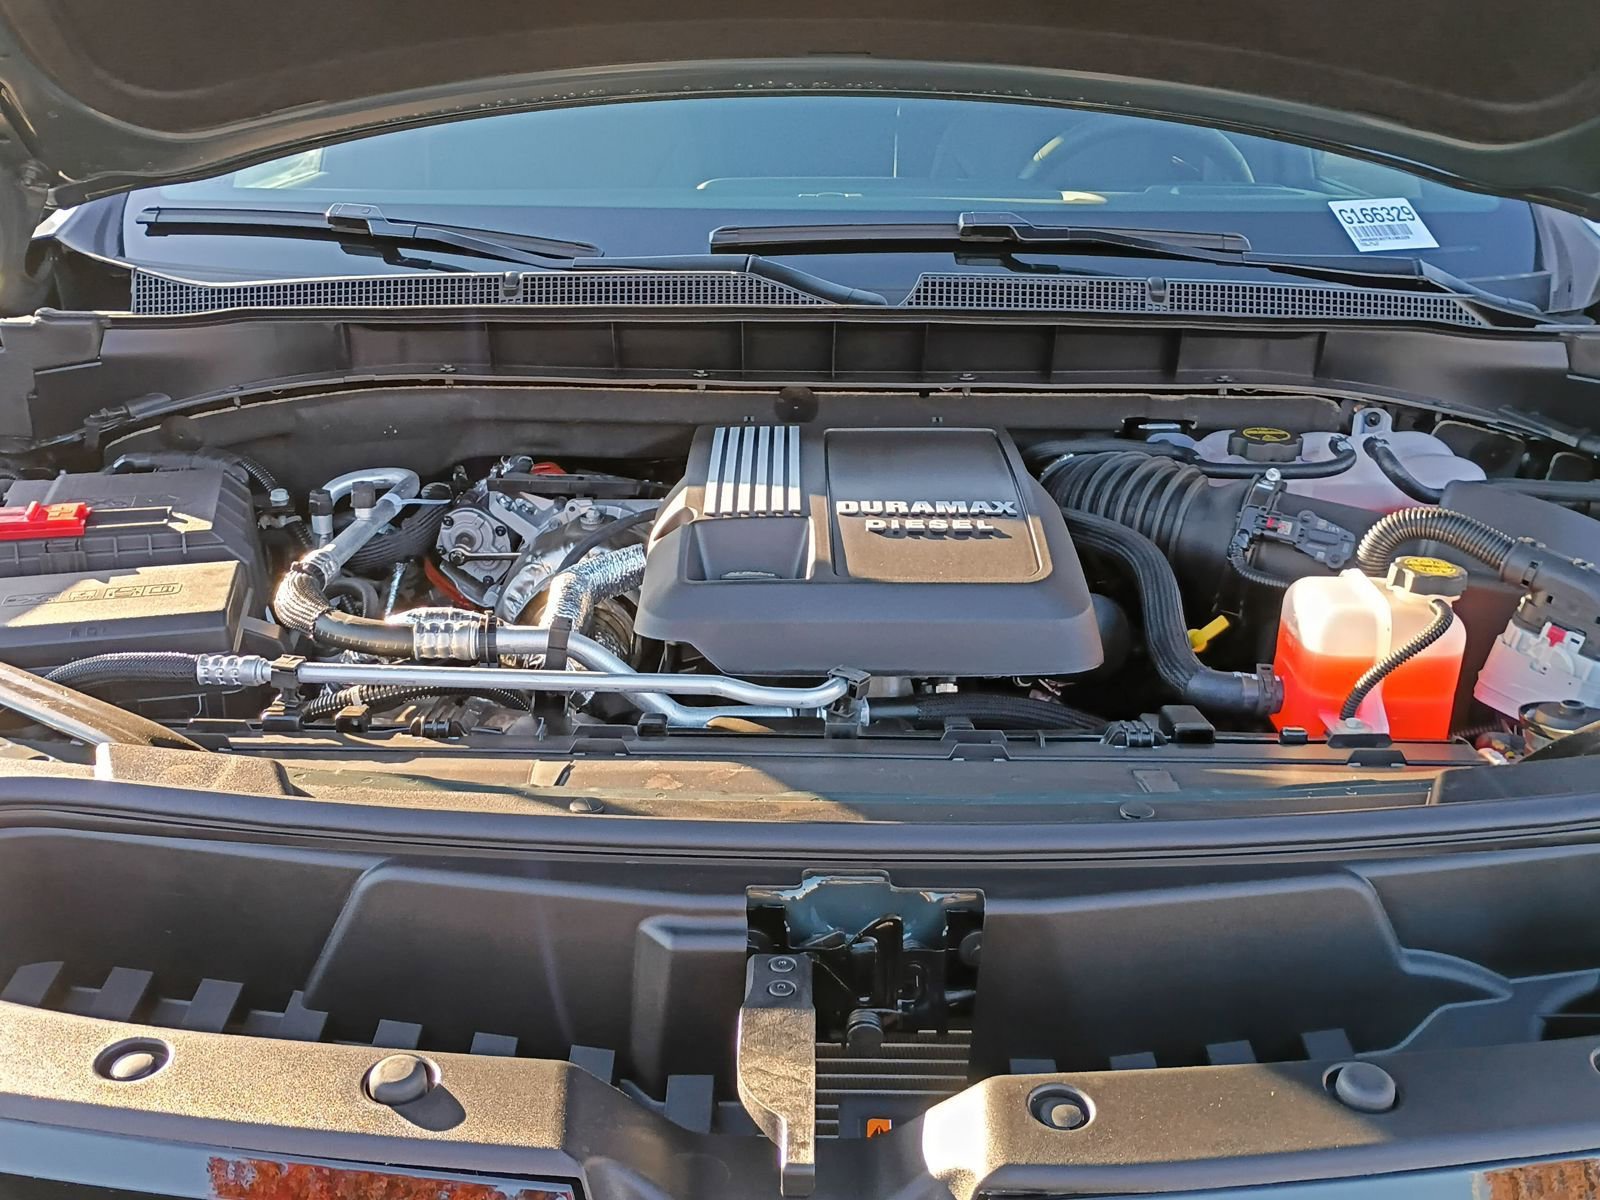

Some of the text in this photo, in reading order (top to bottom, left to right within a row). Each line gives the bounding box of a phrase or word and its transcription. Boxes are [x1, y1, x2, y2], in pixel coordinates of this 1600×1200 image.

[1338, 206, 1416, 225] G166329
[836, 500, 1017, 516] DURAMAX
[865, 519, 994, 532] DIESEL
